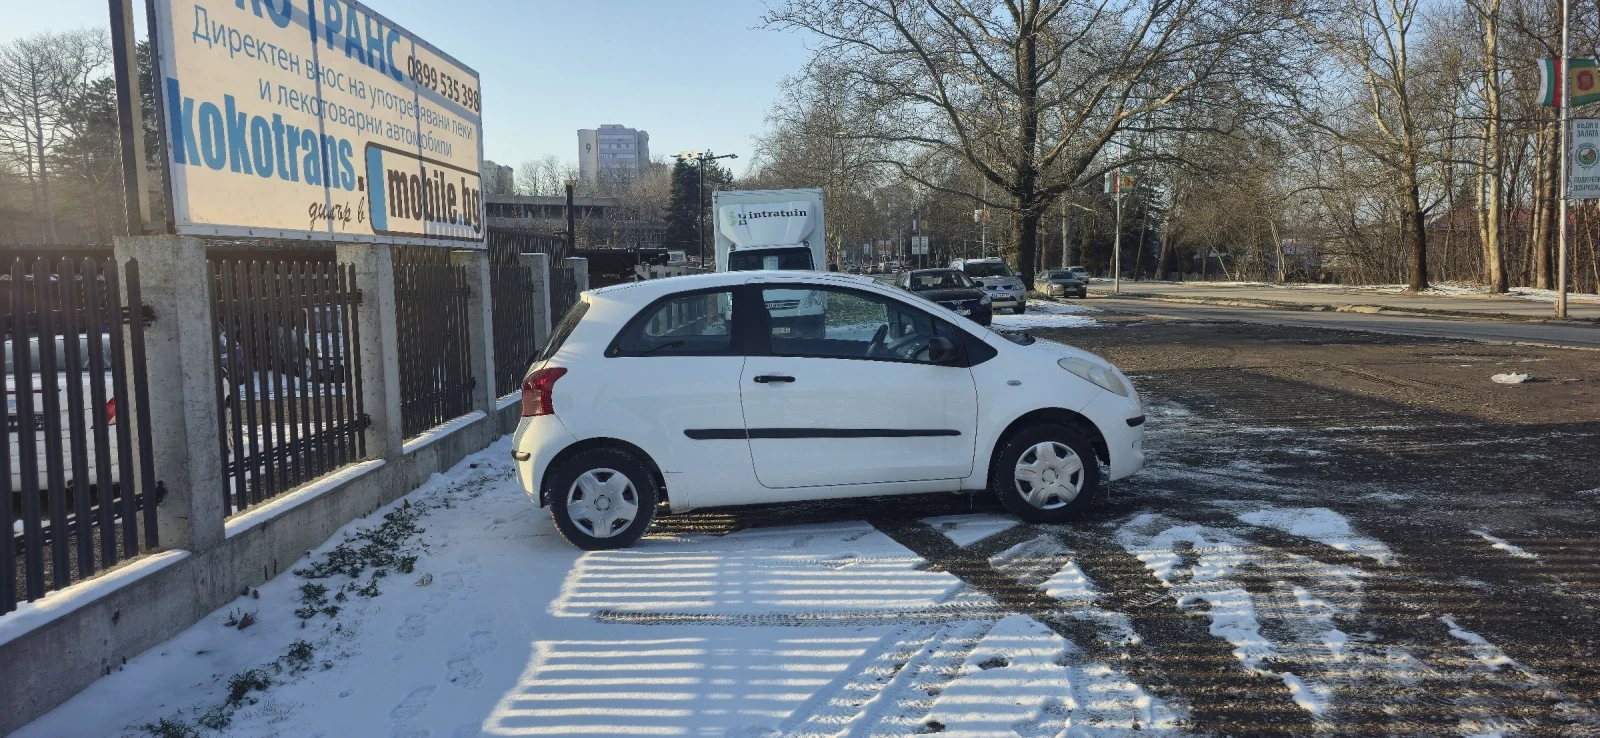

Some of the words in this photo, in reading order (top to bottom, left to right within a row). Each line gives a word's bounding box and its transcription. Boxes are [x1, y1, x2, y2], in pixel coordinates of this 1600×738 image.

[192, 4, 301, 76] Директен
[305, 59, 345, 92] внос
[348, 77, 366, 100] на
[369, 84, 450, 132] употребявани
[452, 120, 473, 140] леки
[407, 55, 438, 92] 0899
[440, 72, 460, 103] 535
[461, 84, 480, 112] 398
[258, 78, 272, 103] и
[277, 84, 383, 137] лекотоварни
[386, 121, 453, 158] автомобили
[1576, 129, 1599, 138] ЗАЛАТА
[585, 142, 592, 154] 9
[387, 166, 482, 234] mobile.bg
[748, 208, 807, 220] intratuin
